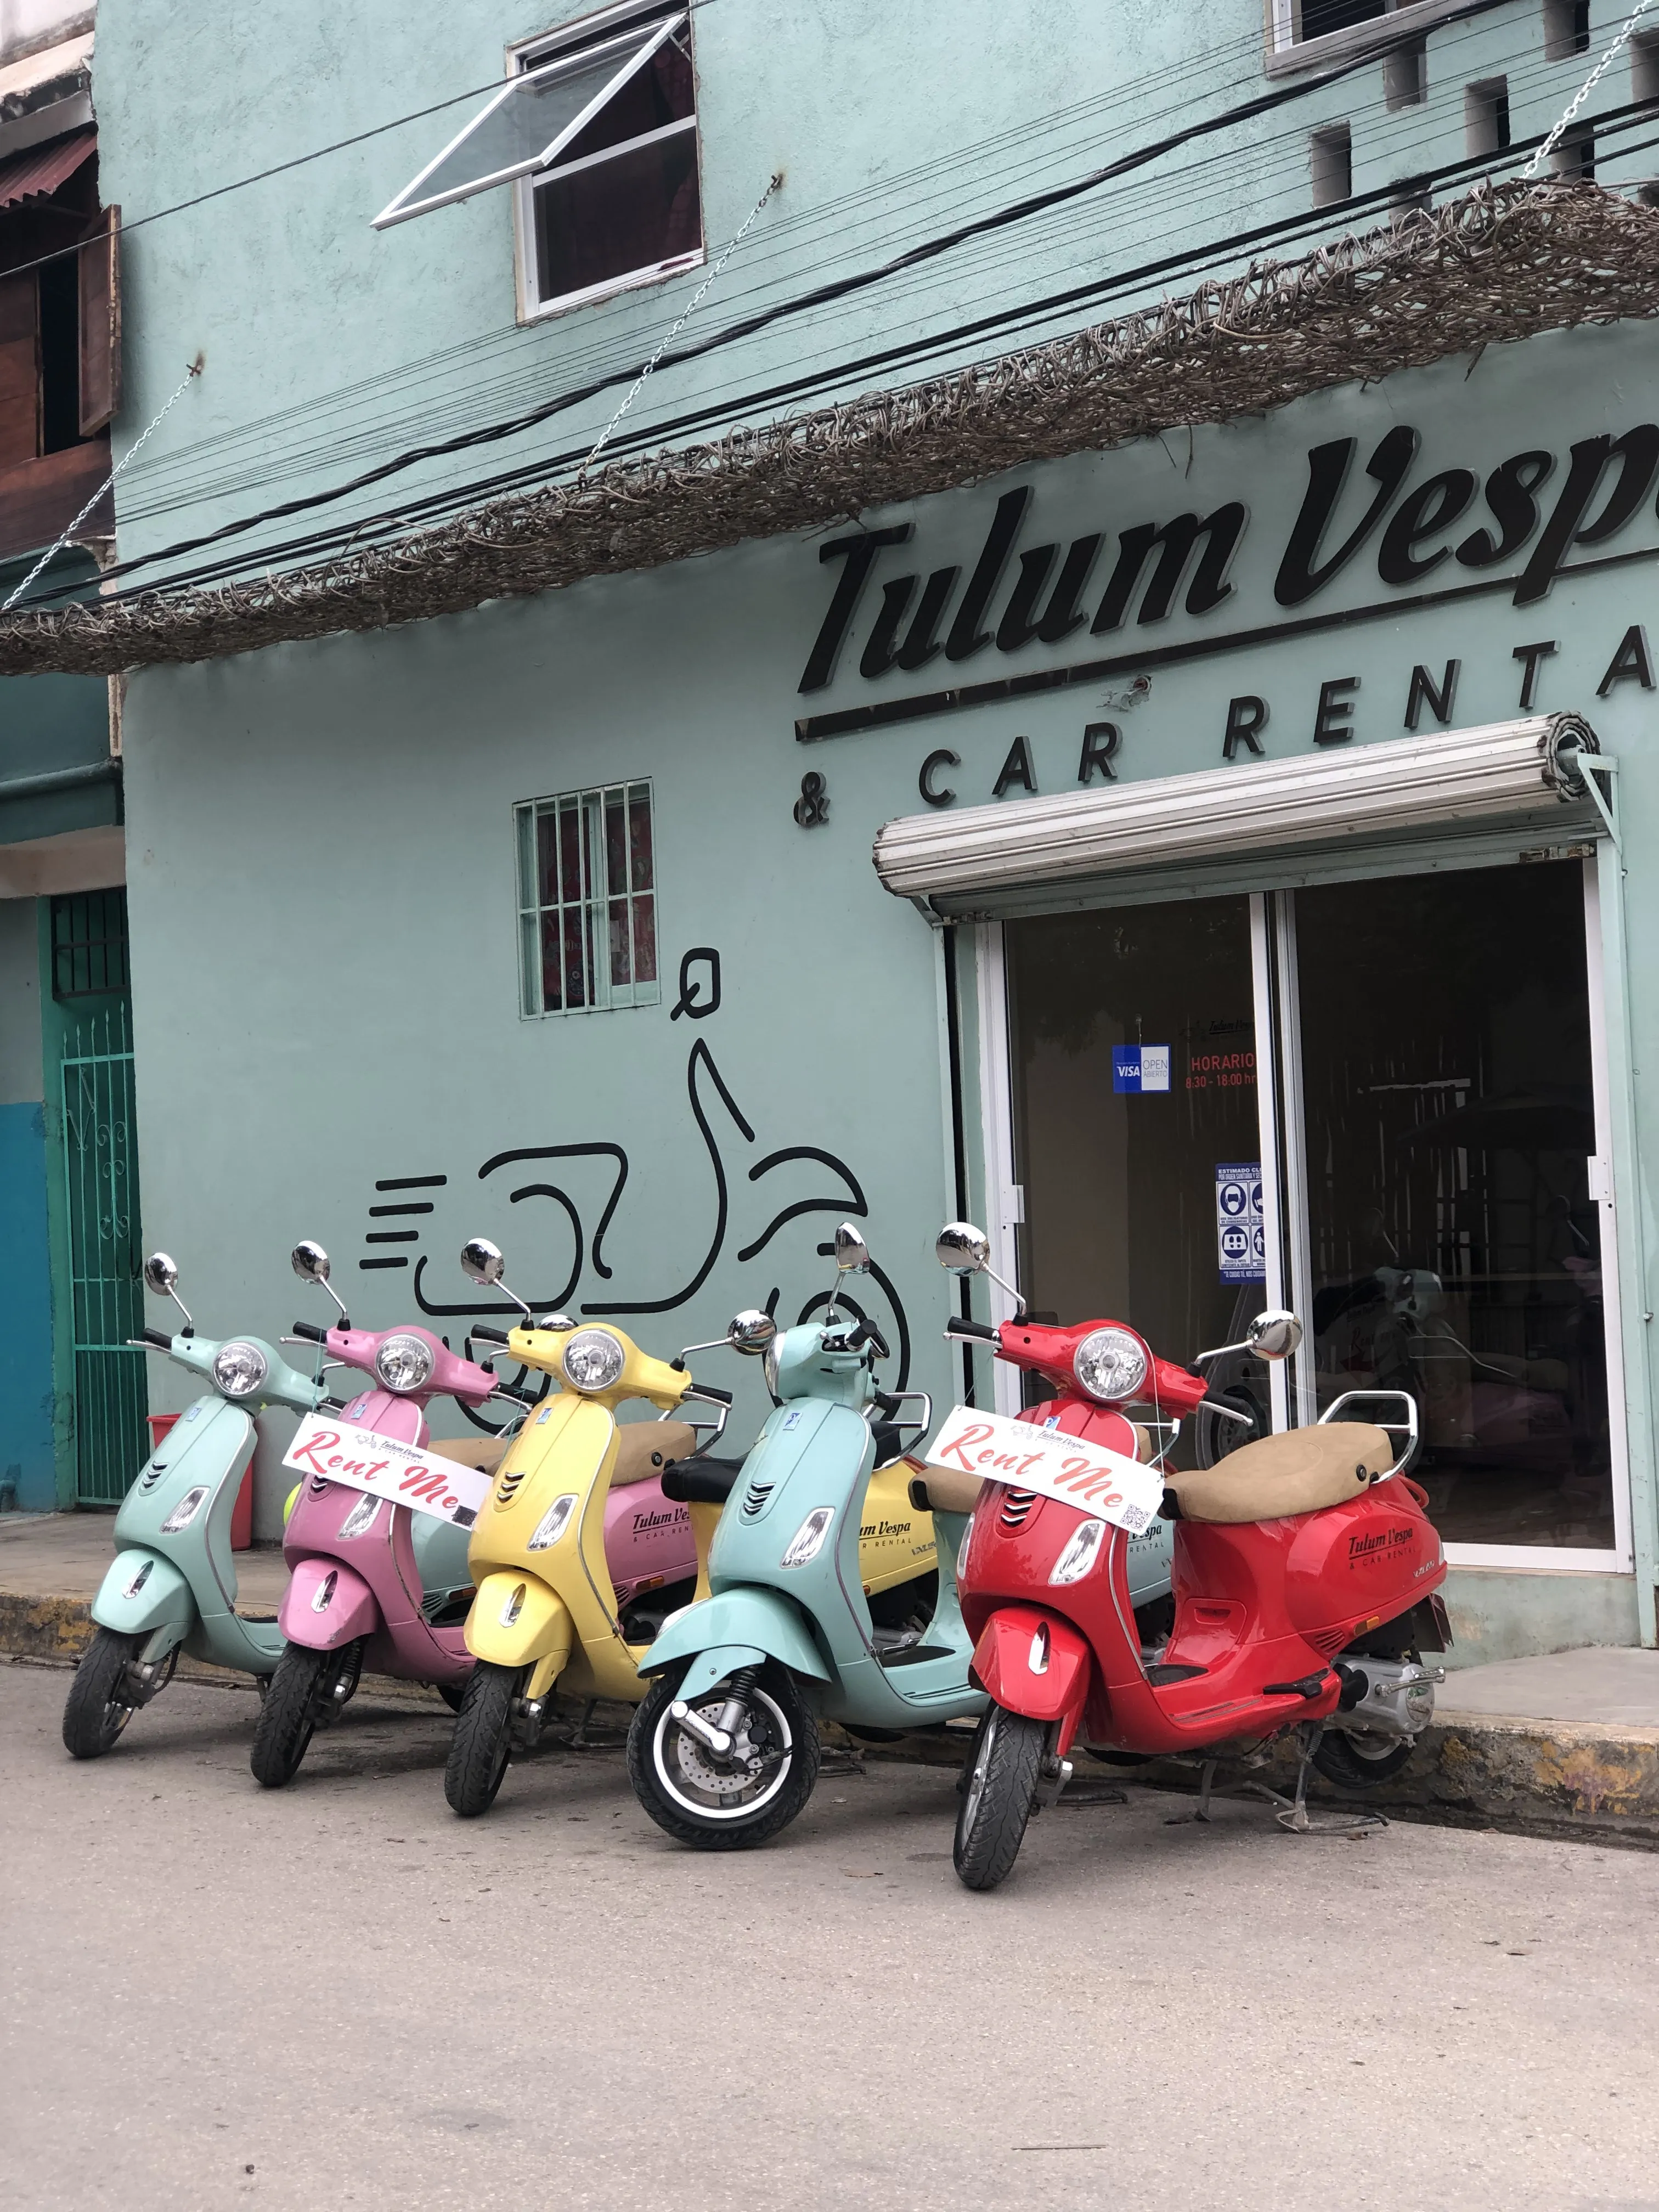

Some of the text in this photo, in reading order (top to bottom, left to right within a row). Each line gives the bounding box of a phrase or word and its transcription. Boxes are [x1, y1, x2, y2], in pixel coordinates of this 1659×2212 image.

[797, 423, 1659, 693] Tulum Vesp
[793, 624, 1656, 826] & CAR RENTA
[1143, 1059, 1167, 1070] OPEN
[1191, 1052, 1255, 1071] HORARIO
[1116, 1066, 1140, 1077] VISA
[1186, 1076, 1206, 1089] 8:30
[1216, 1073, 1242, 1087] 18:00
[1039, 1430, 1063, 1441] Tulum
[1063, 1438, 1085, 1449] Vespa
[381, 1440, 424, 1460] Tulum Vespa
[292, 1431, 459, 1509] Rent Me
[940, 1424, 1123, 1508] Rent Me
[633, 1510, 672, 1530] Tulum
[878, 1521, 911, 1537] Vespa
[875, 1538, 911, 1548] RENTAL
[1129, 1542, 1164, 1553] RENTAL
[1348, 1527, 1413, 1555] Tulum Vespa
[1387, 1547, 1417, 1560] RENTAL
